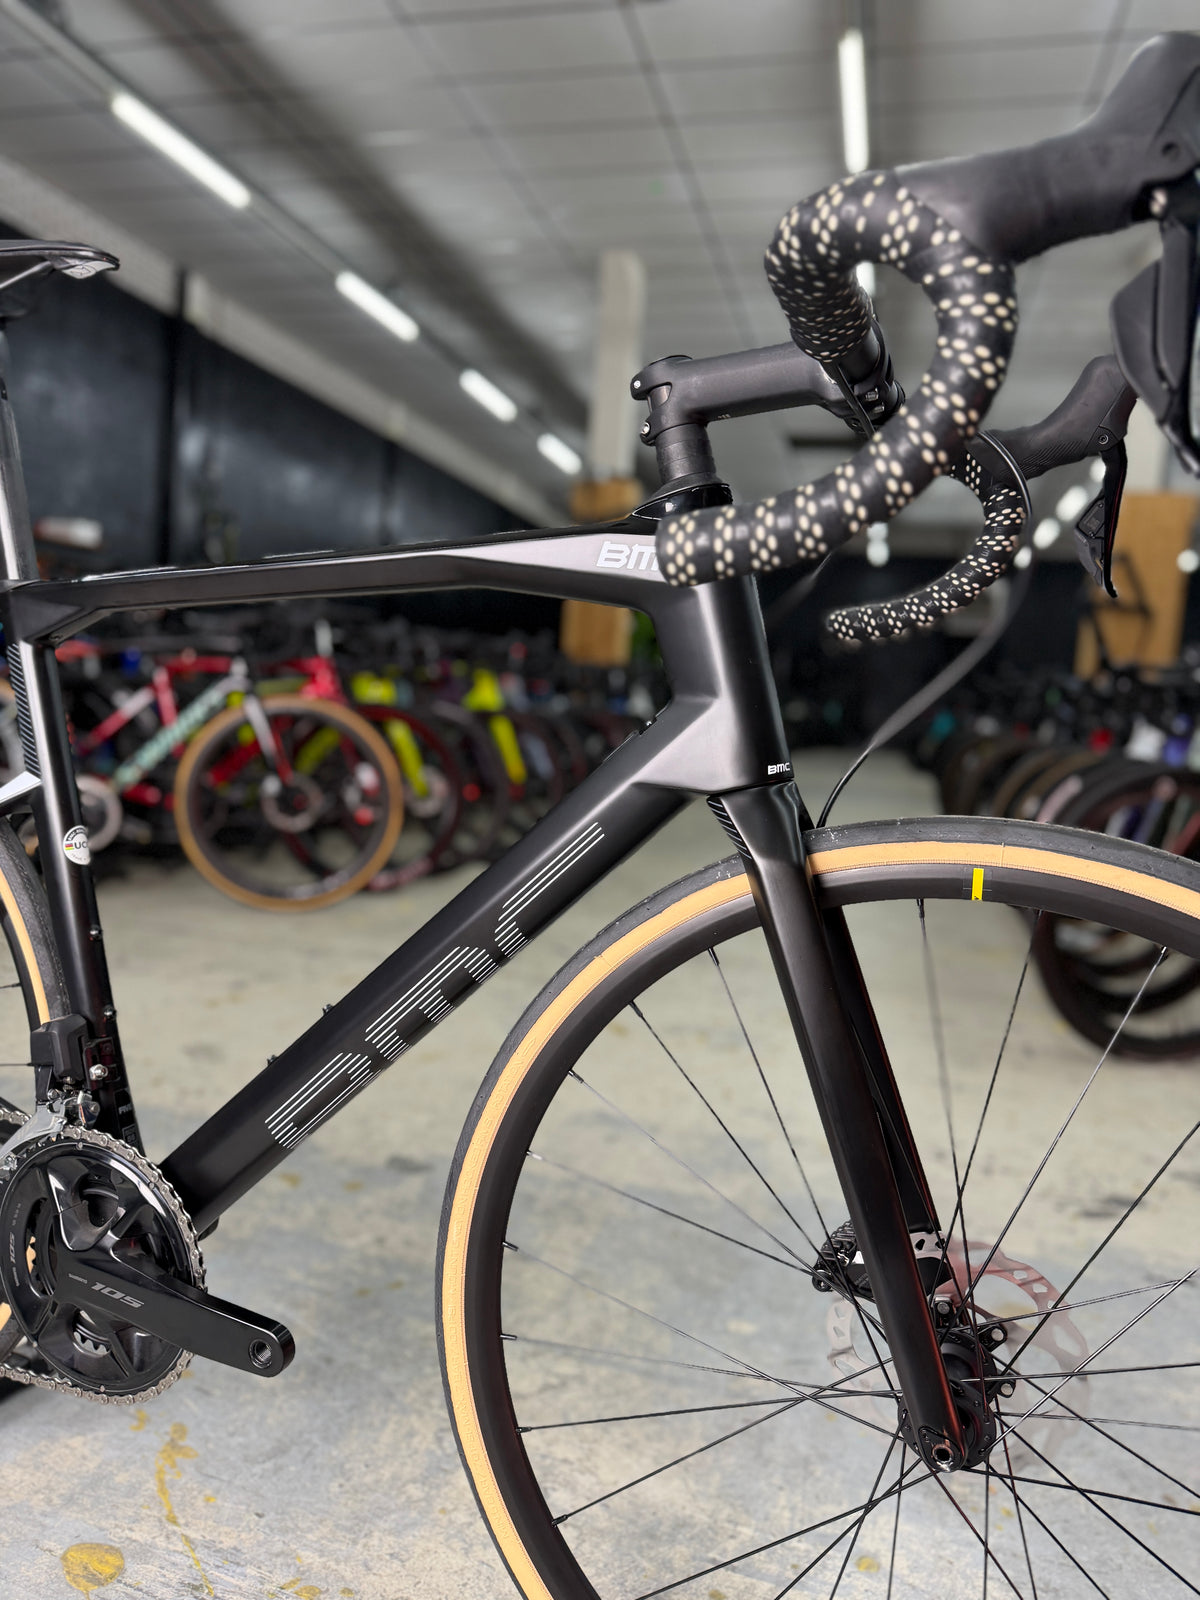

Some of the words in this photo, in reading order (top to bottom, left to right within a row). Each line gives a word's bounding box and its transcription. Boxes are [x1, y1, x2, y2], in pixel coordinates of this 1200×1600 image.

[596, 540, 659, 571] BM
[767, 762, 790, 775] BMC
[74, 841, 88, 850] UC
[91, 1281, 145, 1308] 105
